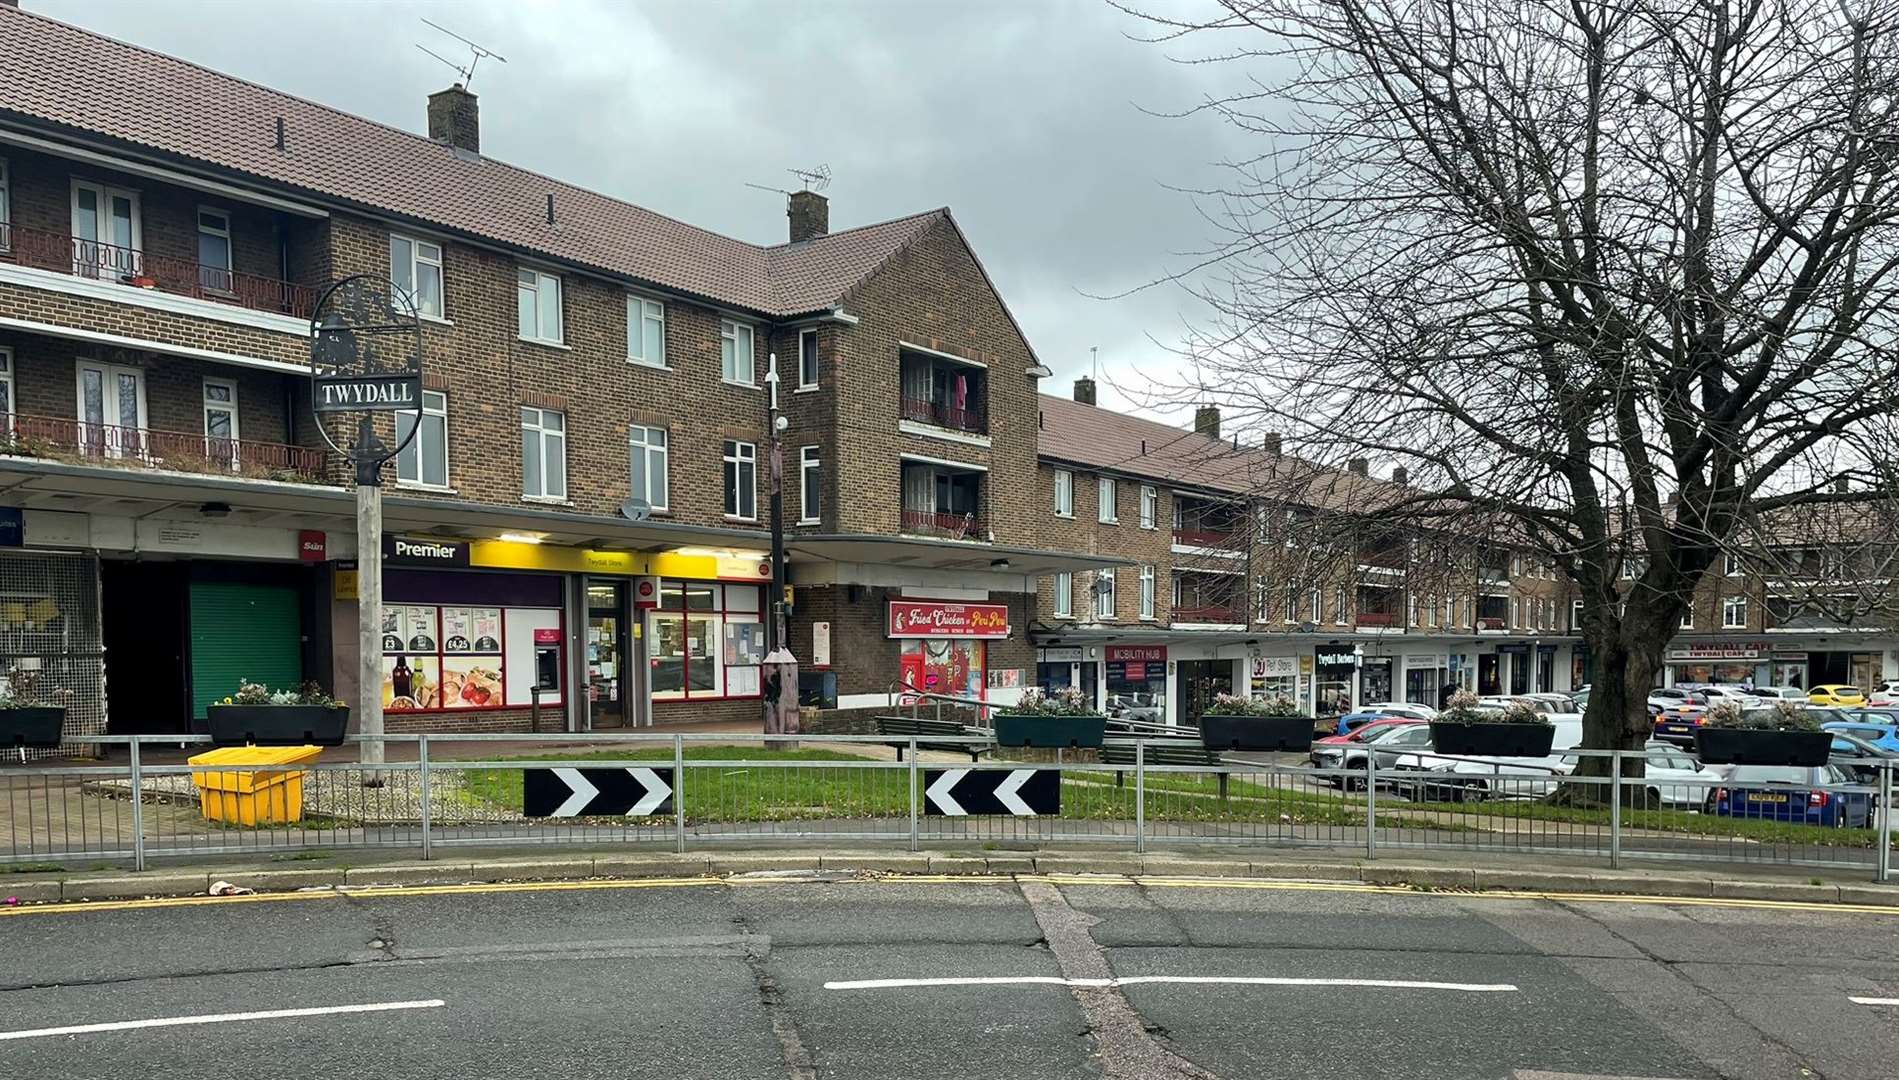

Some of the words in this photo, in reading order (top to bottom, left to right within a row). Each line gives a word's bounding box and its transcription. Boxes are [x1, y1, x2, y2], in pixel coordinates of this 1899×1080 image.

[322, 382, 413, 404] TWYDALL
[303, 541, 324, 552] Sun
[395, 541, 456, 559] Premier
[908, 608, 932, 626] Fried
[932, 609, 965, 627] Chicken
[384, 639, 395, 649] £3
[1113, 648, 1145, 660] MOBILITY
[1145, 649, 1161, 660] HUB
[1266, 659, 1277, 672] Pet
[1277, 659, 1292, 672] Store
